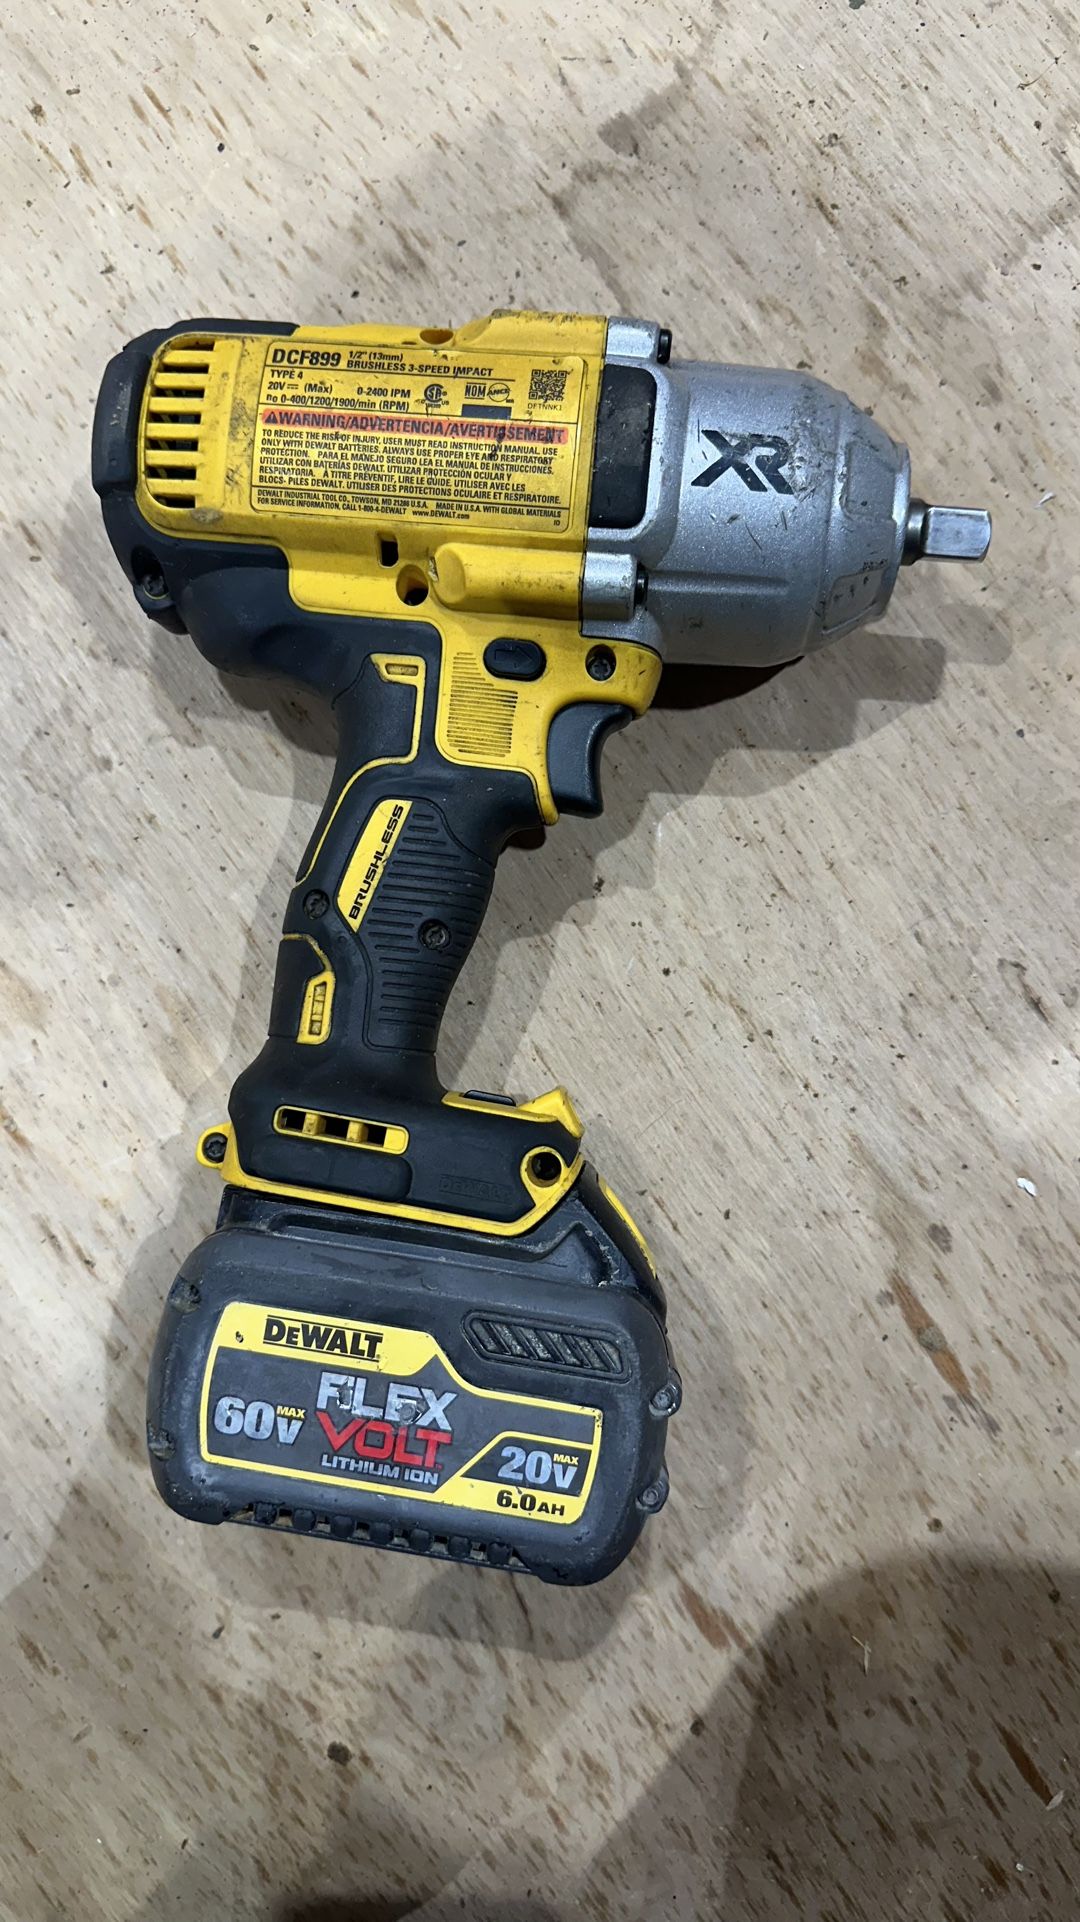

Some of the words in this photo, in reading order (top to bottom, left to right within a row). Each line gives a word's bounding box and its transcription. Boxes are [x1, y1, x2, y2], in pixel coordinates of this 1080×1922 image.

[272, 349, 342, 367] DCF899
[368, 351, 403, 362] (13mm)
[347, 360, 406, 372] BRUSHLESS
[408, 363, 450, 374] 3-SPEED
[453, 367, 494, 377] IMPACT
[270, 369, 295, 379] TYPE
[297, 371, 303, 379] 4
[267, 381, 285, 391] 20V
[304, 383, 333, 394] (Max)
[357, 387, 388, 397] 0-2400
[391, 388, 411, 398] IPM
[465, 383, 486, 398] NOM
[281, 394, 376, 409] 0-400/1200/1900/min
[379, 400, 410, 413] (RPM)
[261, 438, 283, 447] ONLY
[283, 439, 303, 448] WITH
[305, 441, 336, 450] DEWALT
[382, 446, 415, 456] ALWAYS
[416, 448, 431, 457] USE
[433, 449, 464, 459] PROPER
[465, 452, 480, 460] EYE
[481, 453, 499, 461] AND
[500, 454, 554, 465] RESPIRATORY
[262, 429, 272, 437] TO
[274, 430, 304, 439] REDUCE
[306, 432, 320, 440] THE
[322, 432, 340, 442] RISK
[341, 434, 350, 442] OF
[352, 435, 381, 445] INJURY,
[383, 437, 404, 446] USER
[404, 439, 427, 447] MUST
[428, 440, 448, 449] READ
[450, 441, 502, 452] INSTRUCTION
[542, 447, 558, 456] USE
[260, 447, 310, 458] PROTECTION.
[318, 451, 339, 460] PARA
[341, 453, 349, 461] EL
[351, 453, 384, 463] MANEJO
[386, 456, 418, 466] SEGURO
[419, 458, 433, 467] LEA
[435, 459, 444, 468] EL
[446, 460, 479, 470] MANUAL
[480, 462, 490, 471] DE
[492, 463, 554, 475] INSTRUCCIONES.
[260, 456, 294, 467] UTILIZAR
[295, 459, 312, 468] CON
[352, 463, 385, 473] DEWALT.
[387, 465, 421, 475] UTILIZAR
[423, 467, 471, 479] PROTECCIÓN
[473, 471, 505, 480] OCULAR
[691, 429, 794, 495] XR
[259, 466, 315, 477] RESPIRATORIA.
[331, 471, 352, 480] TITRE
[398, 475, 415, 484] LIRE
[416, 477, 425, 485] LE
[427, 478, 452, 487] GUIDE.
[454, 480, 488, 490] UTILISER
[490, 482, 510, 491] AVEC
[512, 484, 526, 492] LES
[259, 475, 286, 485] BLOCS-
[288, 477, 309, 486] PILES
[311, 479, 345, 489] DEWALT.
[346, 481, 380, 492] UTILISER
[381, 484, 397, 493] DES
[398, 486, 452, 497] PROTECTIONS
[454, 489, 491, 499] OCULAIRE
[493, 492, 503, 500] ET
[504, 493, 561, 504] RESPIRATOIRE.
[257, 497, 269, 505] FOR
[271, 498, 296, 507] SERVICE
[342, 503, 357, 511] CALL
[358, 505, 407, 515] 1-800-4-DEWALT
[412, 510, 470, 520] www.DEWALT.com
[258, 489, 283, 498] DEWALT
[284, 491, 320, 500] INDUSTRIAL
[321, 493, 337, 502] TOOL
[411, 500, 428, 509] U.S.A.
[436, 502, 455, 510] MADE
[464, 504, 482, 512] U.S.A.
[483, 506, 500, 514] WITH
[501, 507, 525, 516] GLOBAL
[526, 508, 561, 518] MATERIALS
[348, 804, 404, 920] BRUSHLESS
[316, 1371, 458, 1431] FLEX
[213, 1396, 305, 1446] 60V
[276, 1405, 306, 1419] MAX
[316, 1411, 452, 1469] VOLT
[321, 1454, 399, 1480] LITHIUM
[404, 1470, 439, 1486] ION
[498, 1445, 578, 1489] 20V
[553, 1453, 579, 1465] MAX
